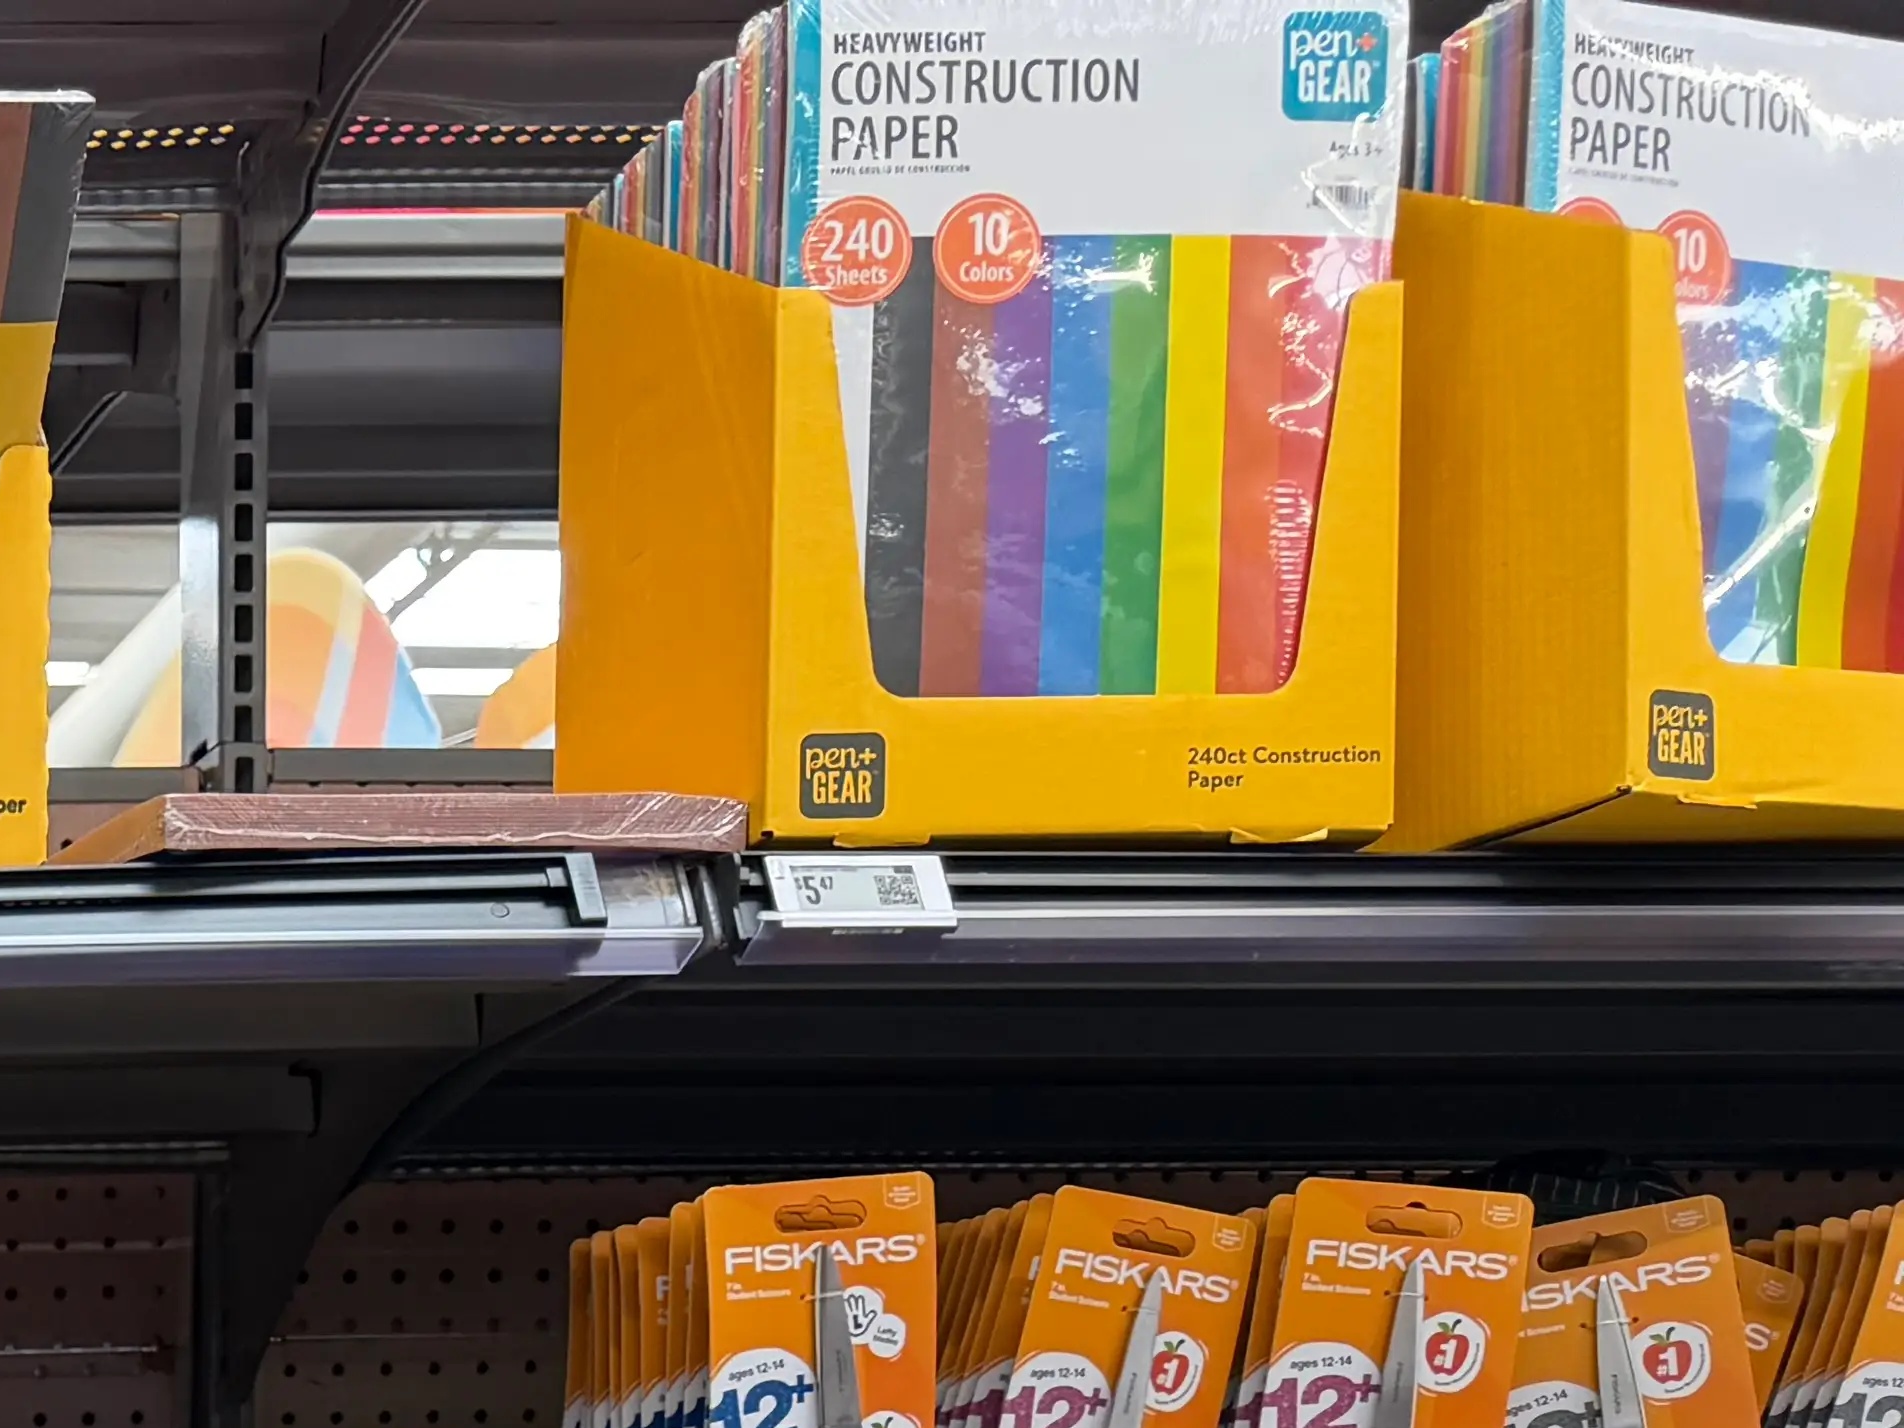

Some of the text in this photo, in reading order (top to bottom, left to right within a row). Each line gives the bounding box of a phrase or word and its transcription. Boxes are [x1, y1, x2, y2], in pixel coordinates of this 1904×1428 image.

[834, 32, 986, 55] HEAVYWEIGHT
[831, 59, 1139, 106] CONSTRUCTION
[831, 115, 958, 162] PAPER
[1570, 117, 1671, 171] PAPER
[822, 219, 894, 261] 240
[970, 212, 1008, 254] 10
[825, 263, 888, 287] Sheets
[960, 258, 1014, 284] Colors
[1188, 746, 1381, 767] 240ct Construction
[813, 769, 873, 804] GEAR
[1188, 771, 1244, 792] Paper
[725, 1233, 918, 1275] FISKARS
[1306, 1239, 1509, 1279] FISKARS
[1055, 1248, 1229, 1304] FISKARS
[728, 1358, 785, 1382] ages 12-14
